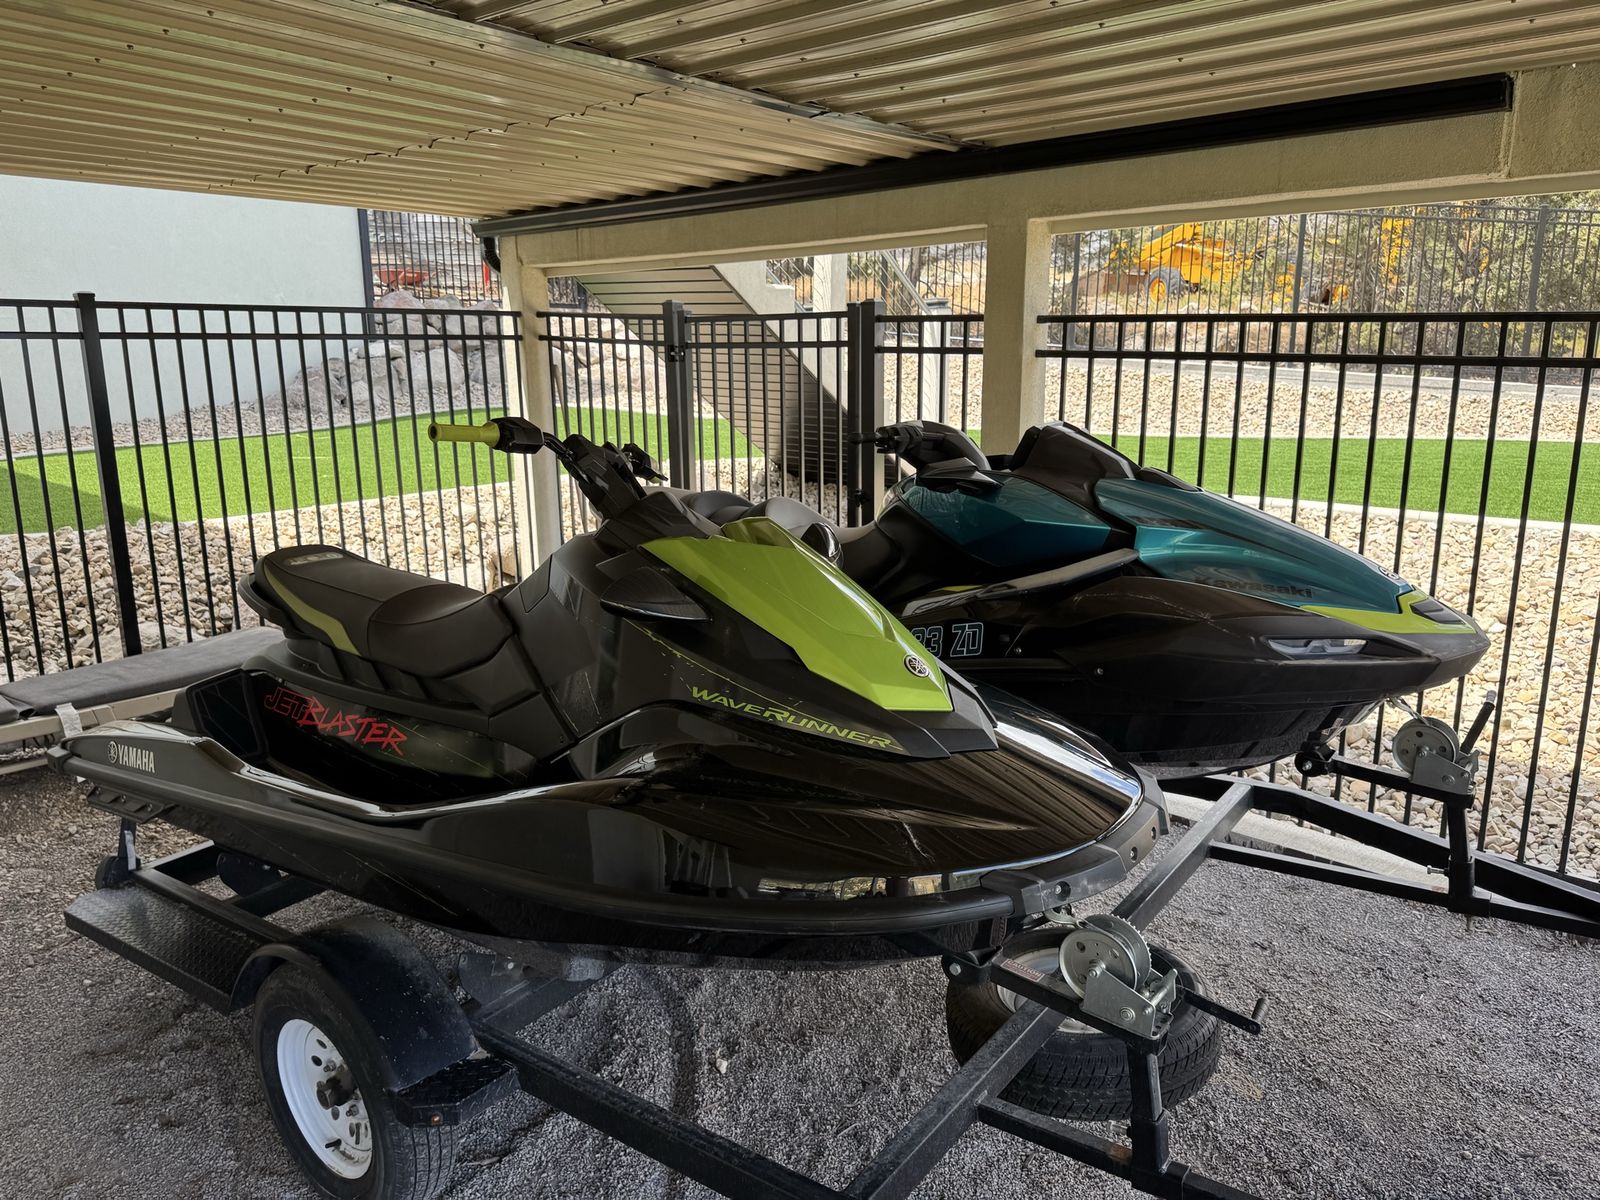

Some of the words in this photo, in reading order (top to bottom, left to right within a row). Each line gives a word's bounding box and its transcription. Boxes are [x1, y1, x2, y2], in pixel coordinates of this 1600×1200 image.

[950, 622, 984, 657] ZD
[692, 686, 893, 748] WAVERUNNER
[118, 744, 155, 773] YAMAHA
